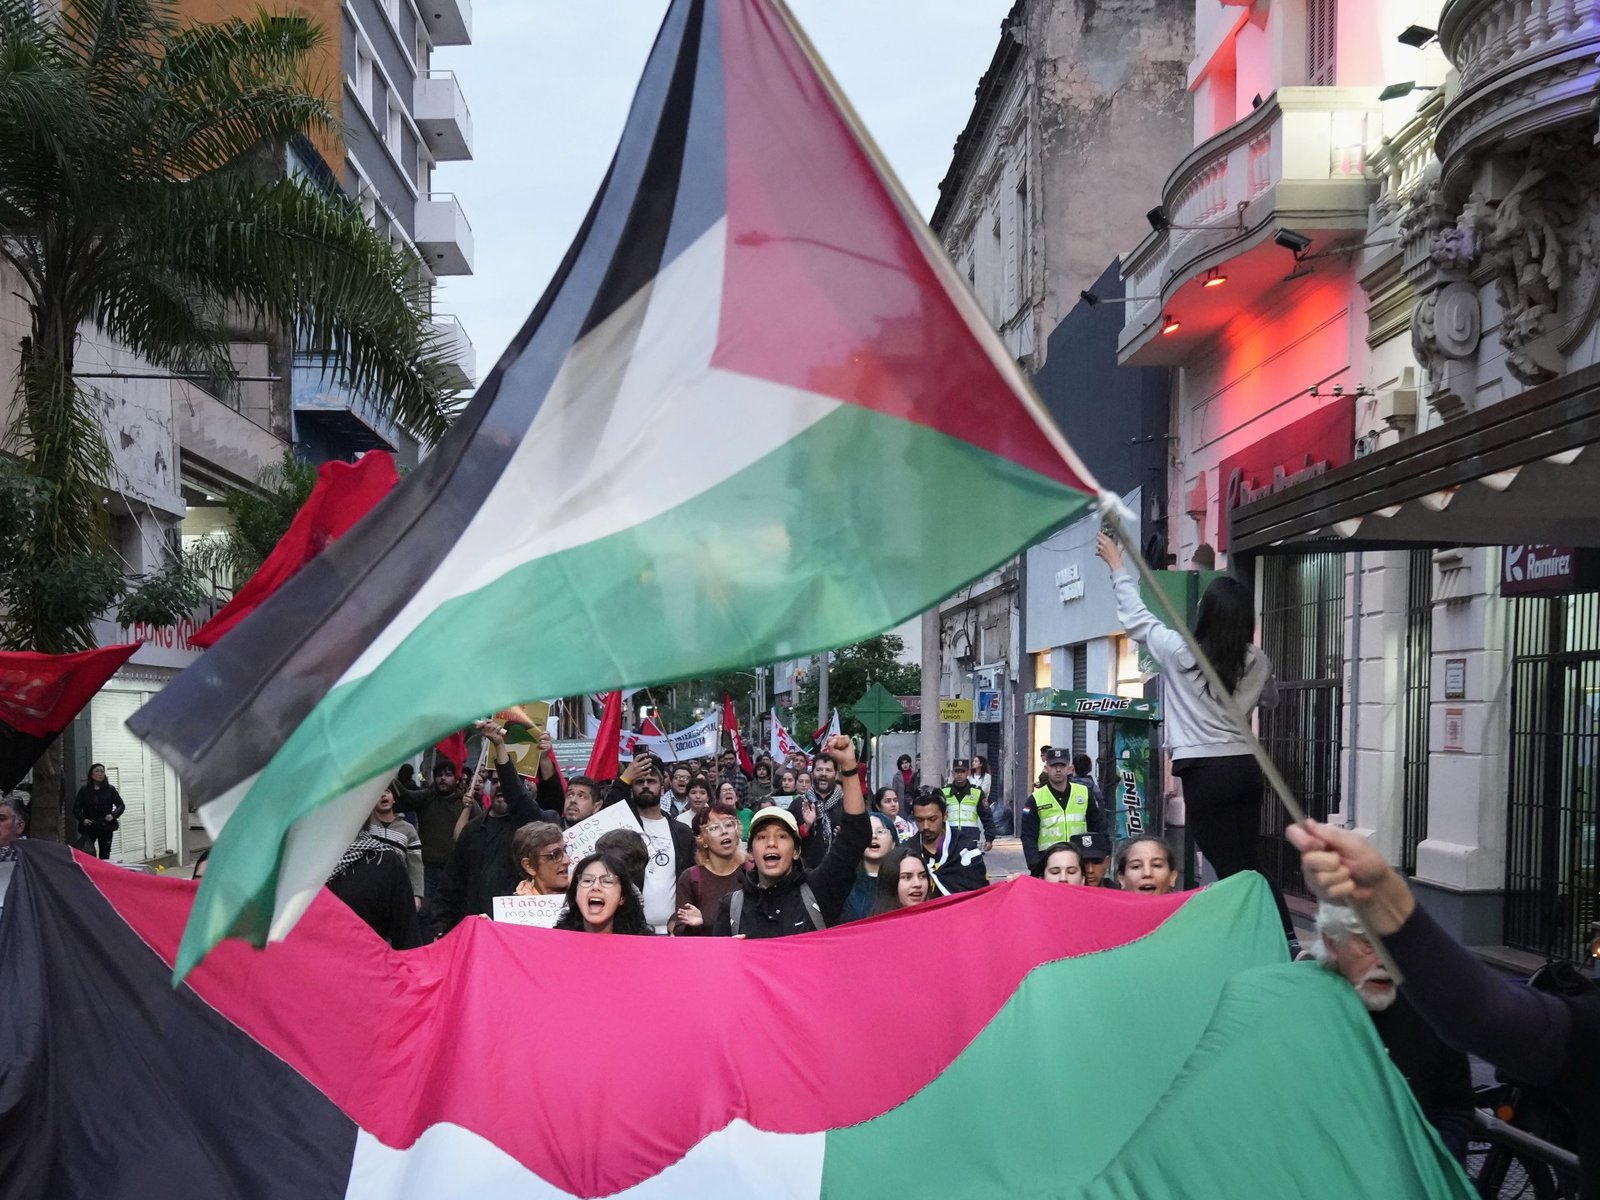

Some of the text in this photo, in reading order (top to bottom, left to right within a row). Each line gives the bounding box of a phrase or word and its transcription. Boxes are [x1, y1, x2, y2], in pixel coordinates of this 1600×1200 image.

[1526, 548, 1570, 580] Ramírez
[134, 616, 210, 652] HONG KON
[578, 818, 600, 832] los
[518, 896, 557, 908] años
[505, 909, 559, 918] masacr
